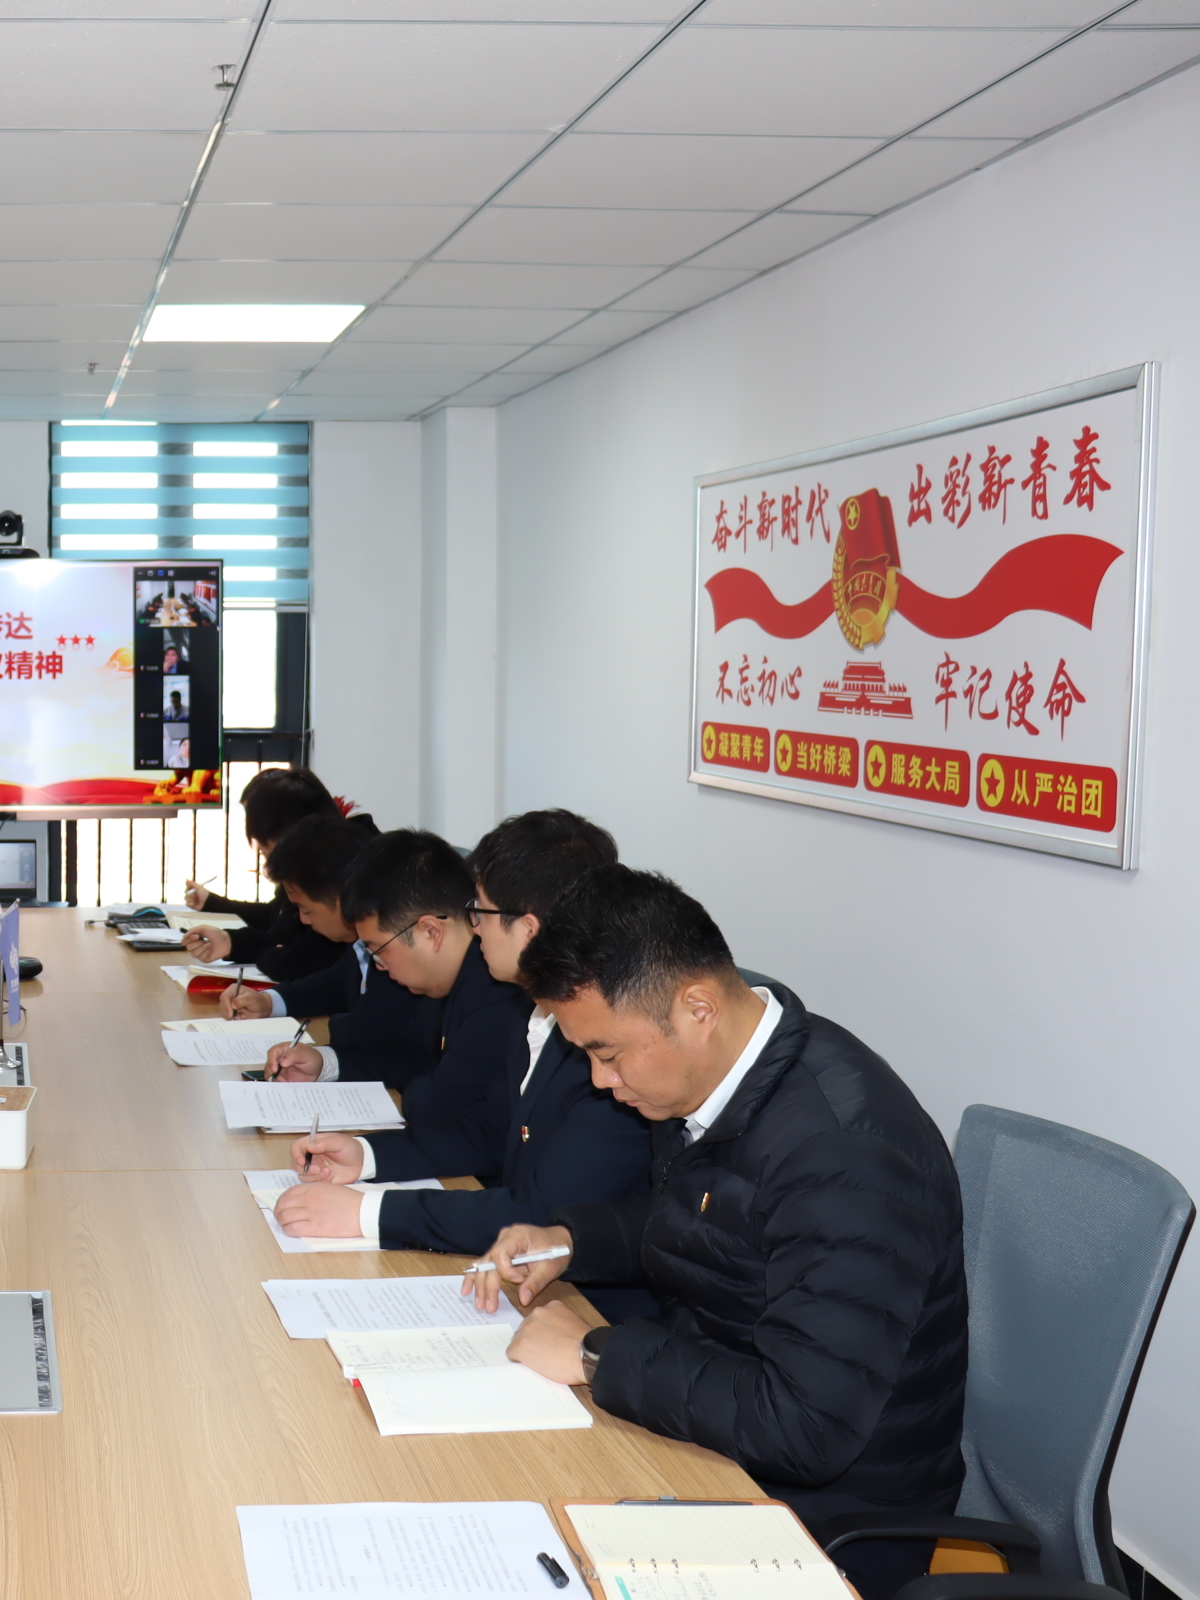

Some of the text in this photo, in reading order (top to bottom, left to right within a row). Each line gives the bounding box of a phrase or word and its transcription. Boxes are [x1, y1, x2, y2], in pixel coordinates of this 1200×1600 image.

[907, 426, 1112, 529] 出彩新青春
[711, 482, 831, 554] 奋斗新时代
[715, 654, 803, 708] 不忘初心
[934, 651, 1087, 742] 牢记使命
[718, 731, 765, 763] 凝聚青年
[796, 741, 852, 777] 当好桥梁
[890, 753, 960, 795] 服务大局
[1011, 768, 1103, 818] 从严治团
